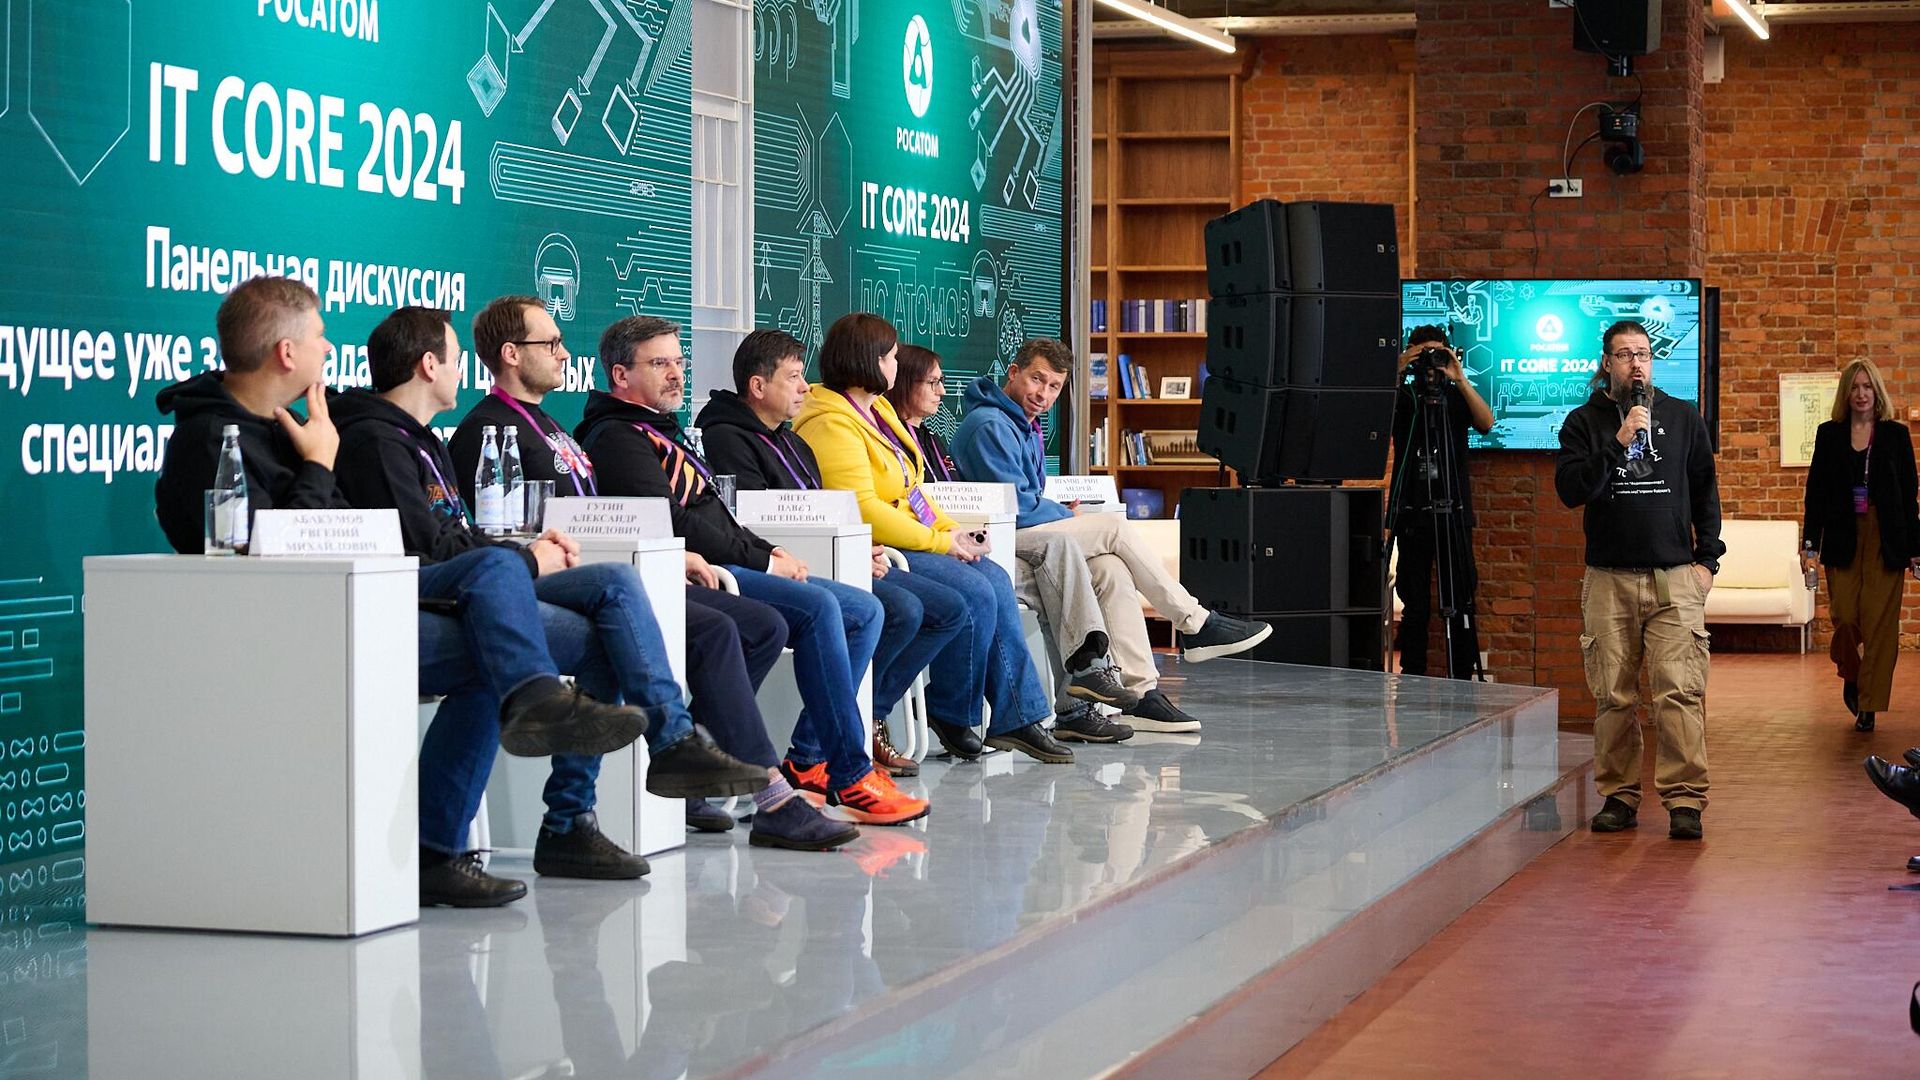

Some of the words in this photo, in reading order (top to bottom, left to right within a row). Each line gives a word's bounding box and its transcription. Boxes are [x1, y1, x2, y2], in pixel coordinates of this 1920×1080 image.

[149, 61, 199, 166] IT
[211, 75, 345, 189] CORE
[357, 102, 465, 205] 2024
[896, 127, 939, 158] РОСАТОМ
[861, 180, 879, 230] IT
[882, 184, 928, 238] CORE
[930, 193, 970, 244] 2024
[325, 259, 465, 313] дискуссия
[124, 332, 192, 399] уже
[1501, 359, 1515, 373] IT
[1518, 359, 1557, 373] CORE
[1561, 359, 1599, 373] 2024
[21, 423, 175, 484] специал
[571, 513, 638, 523] АЛЕКСАНДР
[586, 502, 624, 511] ГУТИН
[564, 525, 641, 534] ЛЕОНИДОВИЧ
